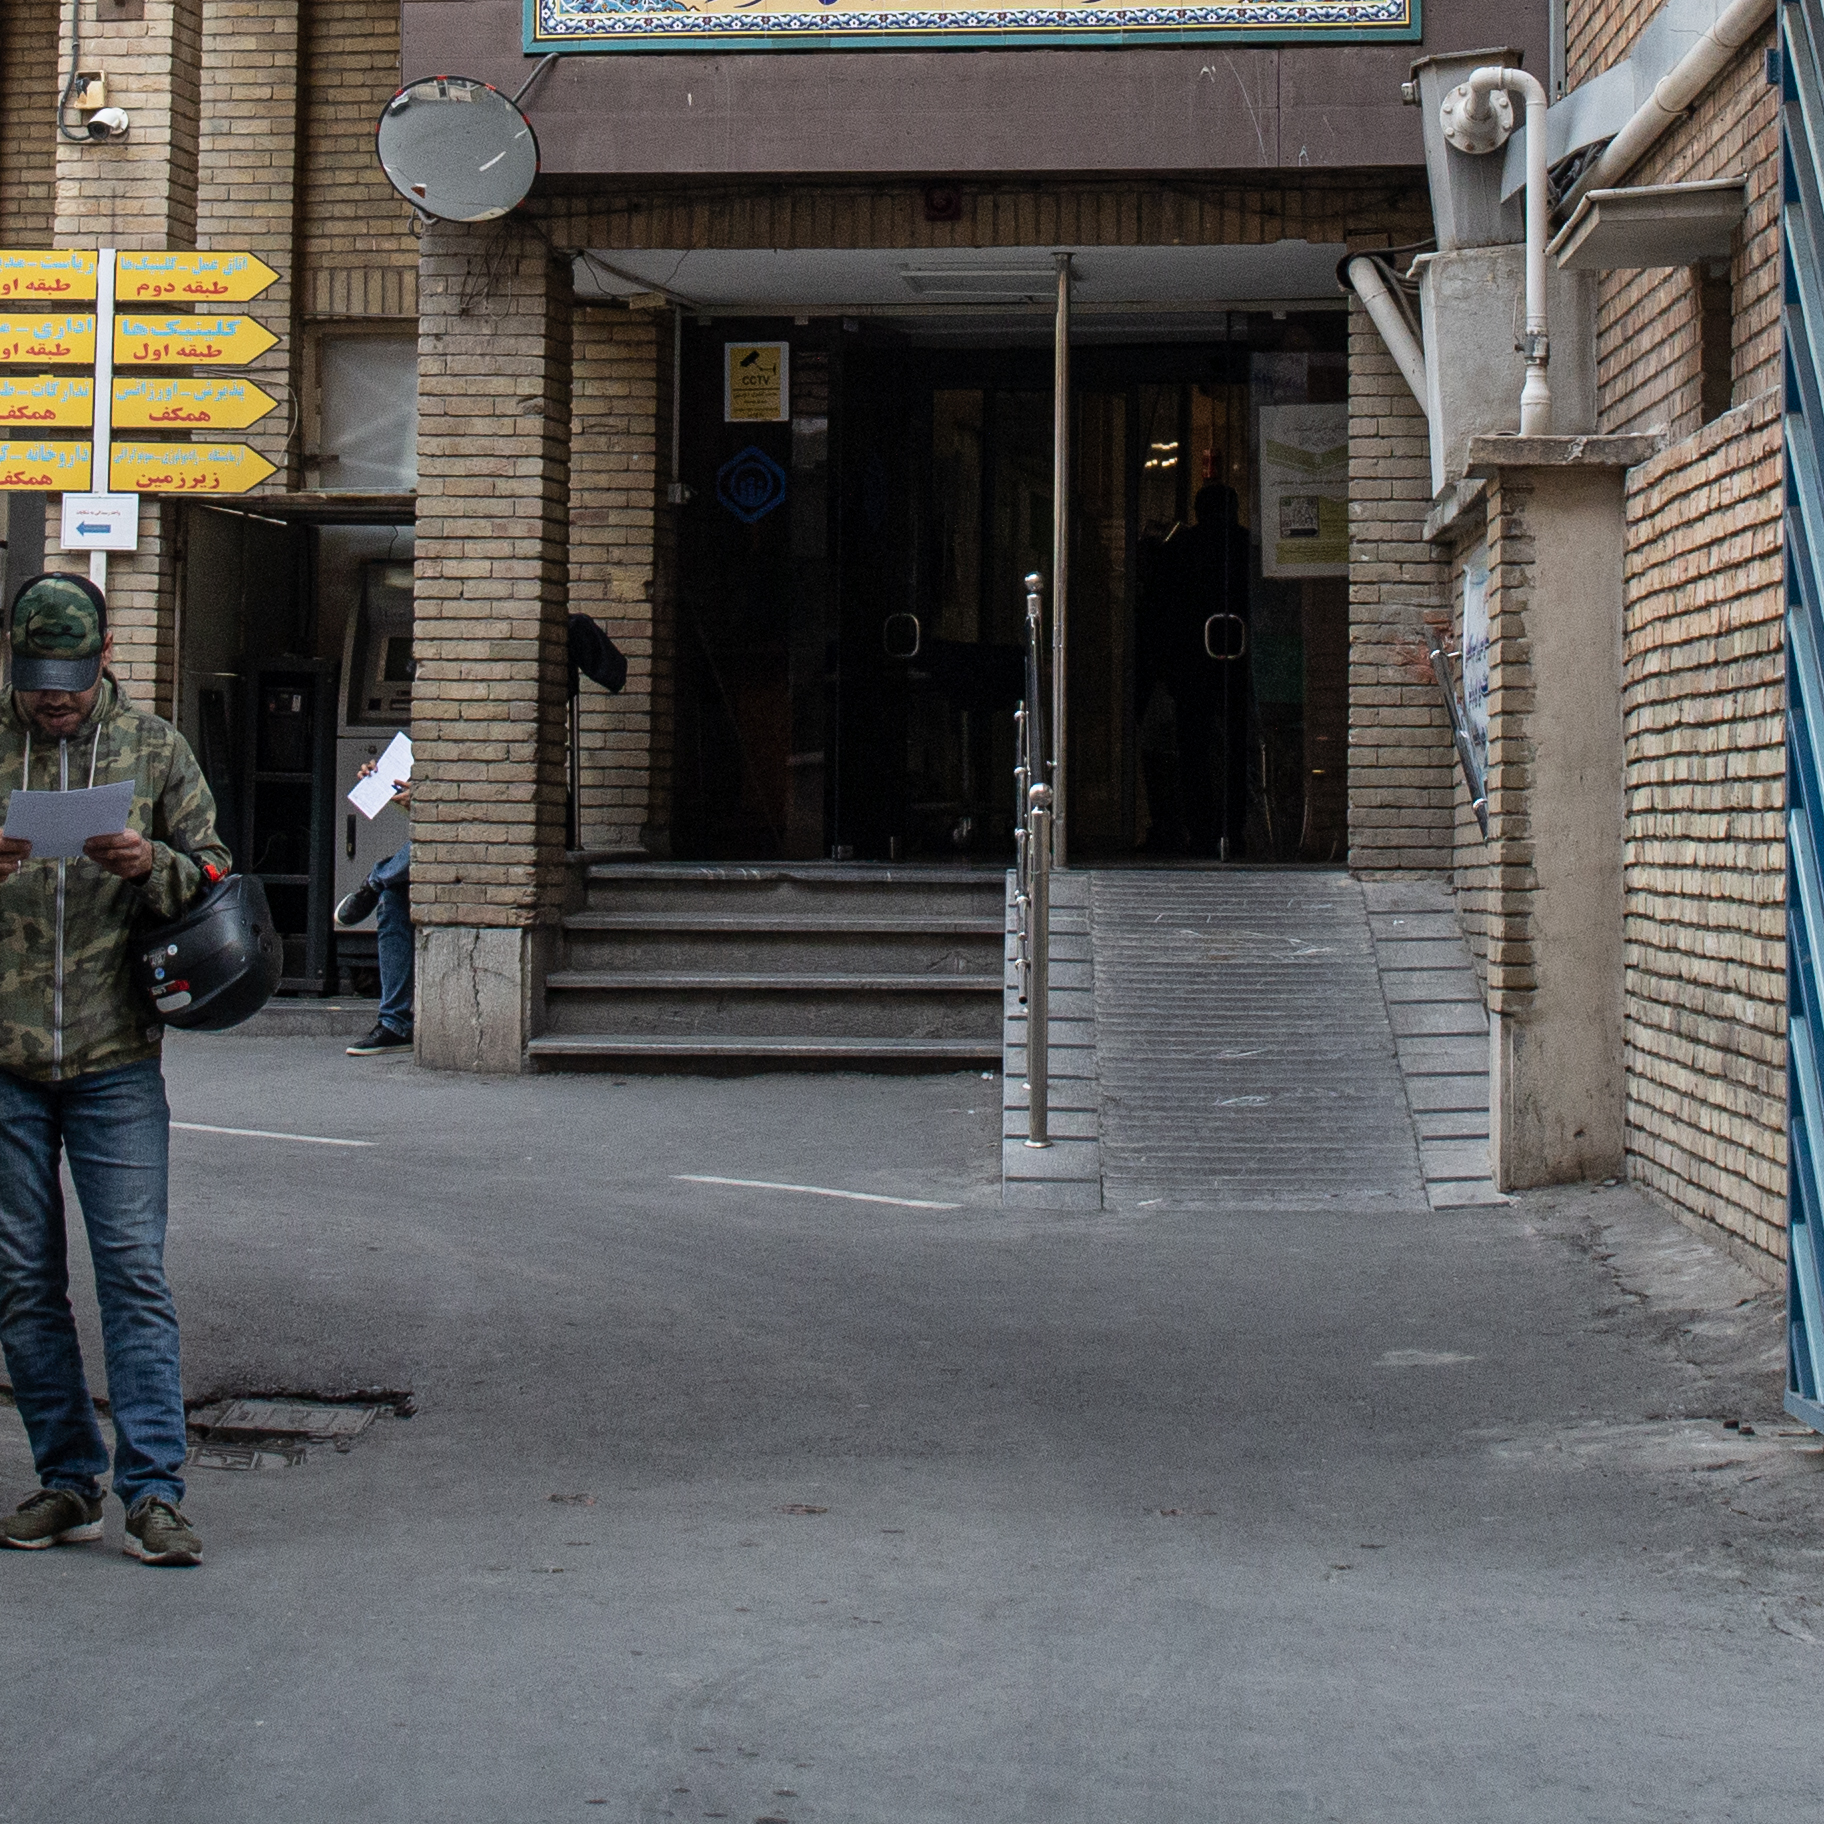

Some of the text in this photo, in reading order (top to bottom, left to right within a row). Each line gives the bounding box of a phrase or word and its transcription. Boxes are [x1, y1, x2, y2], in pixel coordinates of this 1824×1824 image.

[191, 256, 219, 276] عمل
[222, 255, 248, 276] اتاق
[25, 277, 72, 296] طبقه
[136, 280, 229, 299] طبقه دوم
[25, 342, 72, 360] طبقه
[133, 342, 224, 362] طبقه اول
[741, 375, 771, 386] CCTV
[148, 406, 212, 423] همکف
